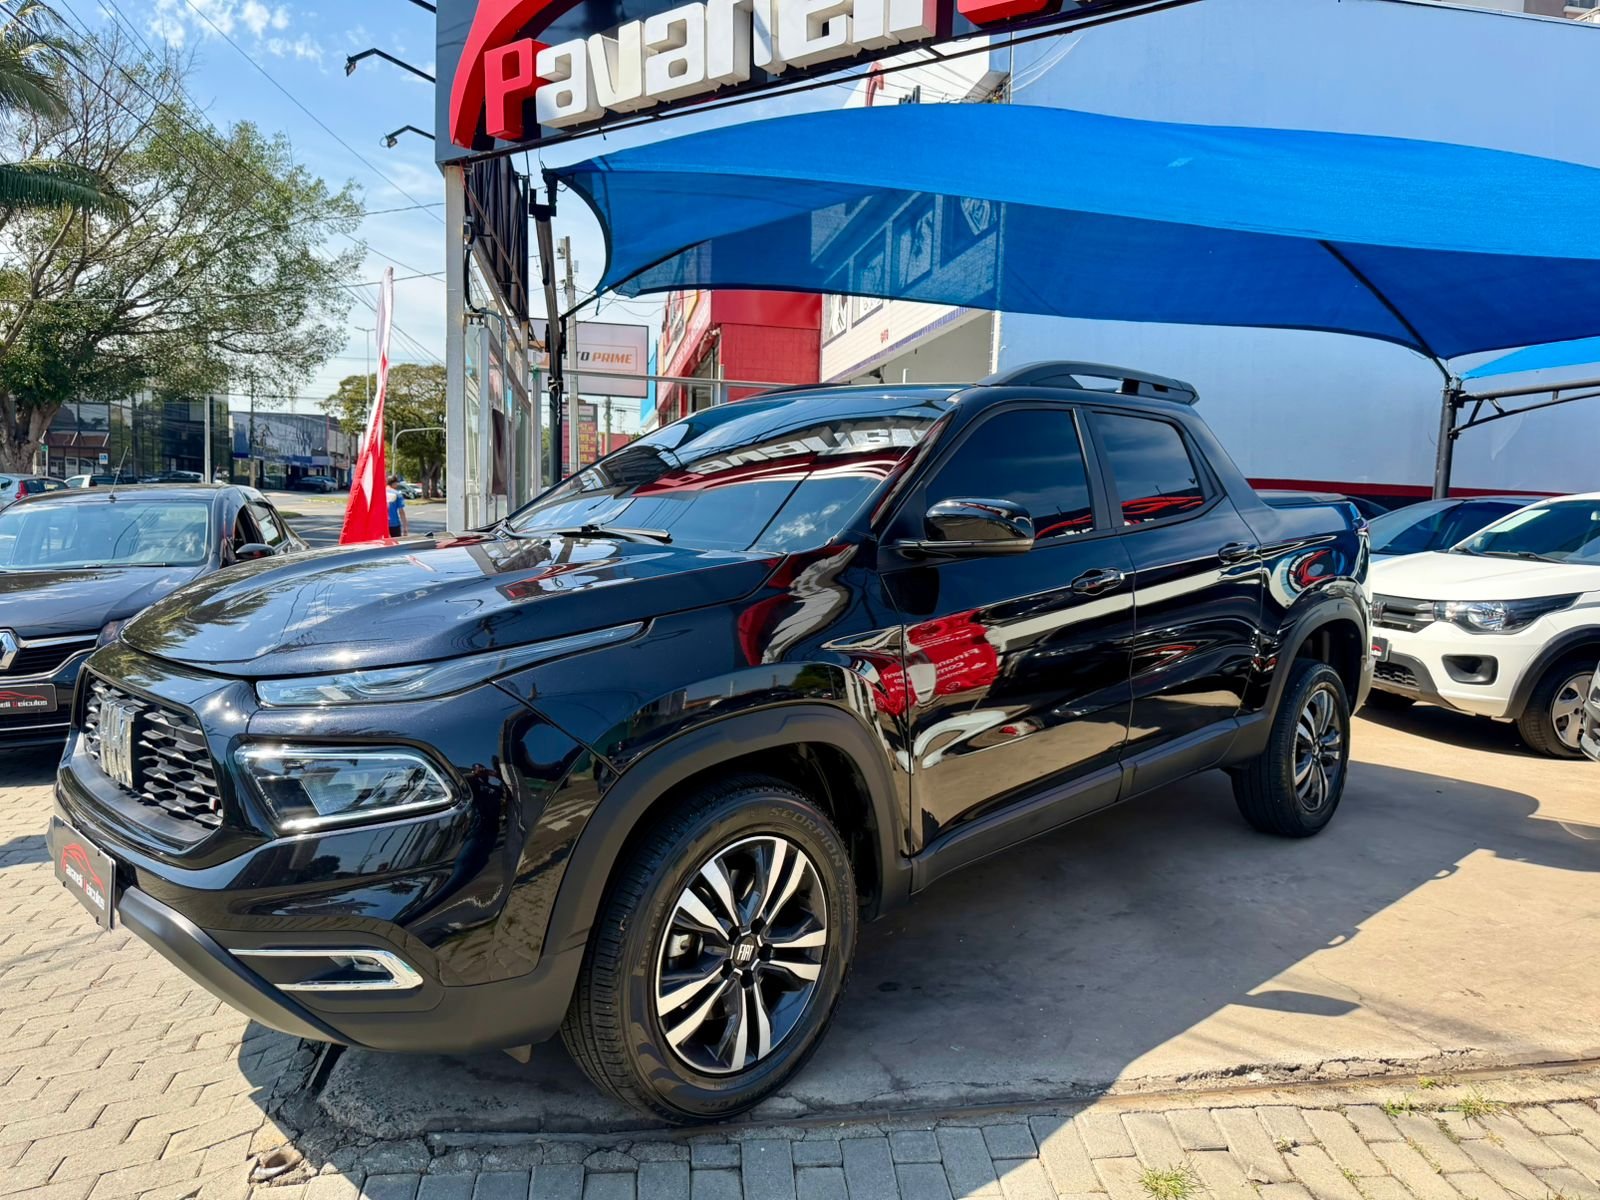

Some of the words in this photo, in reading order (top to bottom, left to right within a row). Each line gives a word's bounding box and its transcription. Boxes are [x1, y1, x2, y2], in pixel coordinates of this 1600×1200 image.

[592, 351, 633, 364] PRIME
[770, 806, 843, 868] SCORPION
[737, 943, 754, 961] FIAT
